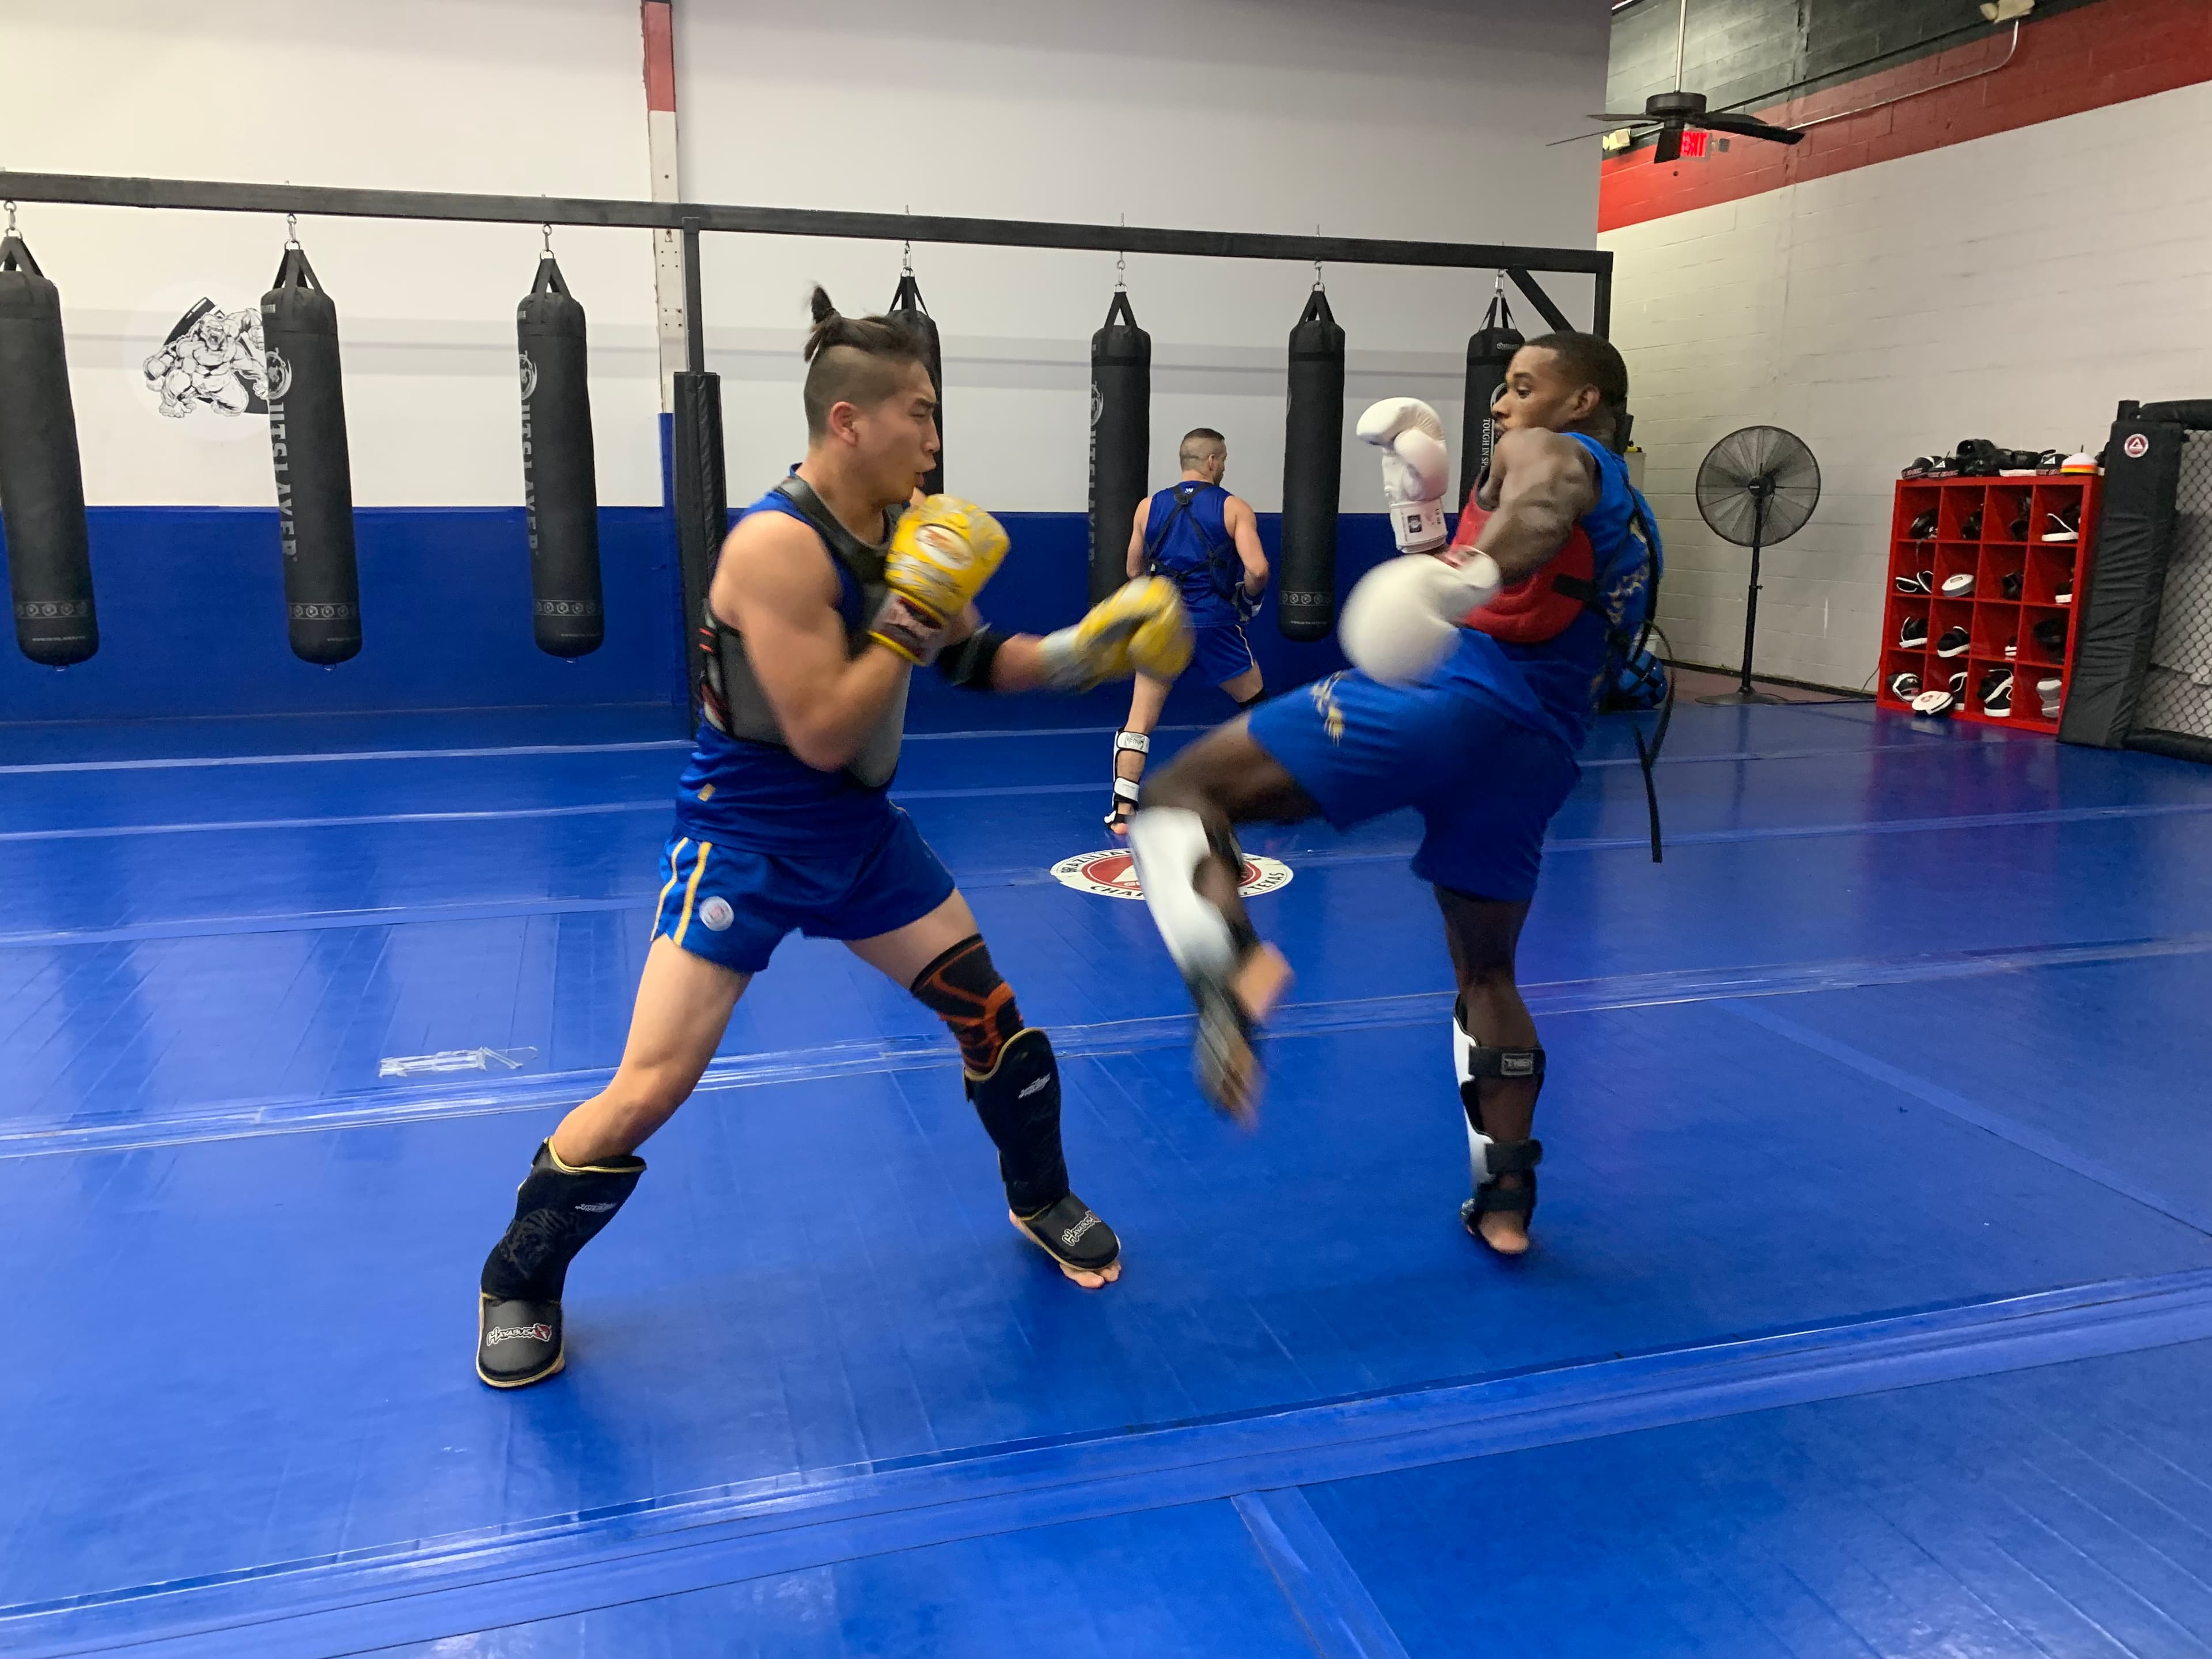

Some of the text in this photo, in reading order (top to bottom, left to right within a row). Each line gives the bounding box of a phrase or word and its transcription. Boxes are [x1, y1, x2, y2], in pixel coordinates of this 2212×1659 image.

[1680, 131, 1708, 157] EXIT
[1482, 418, 1491, 446] TOUGH
[1482, 447, 1490, 456] IN
[1247, 873, 1285, 890] TEXAS
[487, 1326, 537, 1346] HAYABUSA
